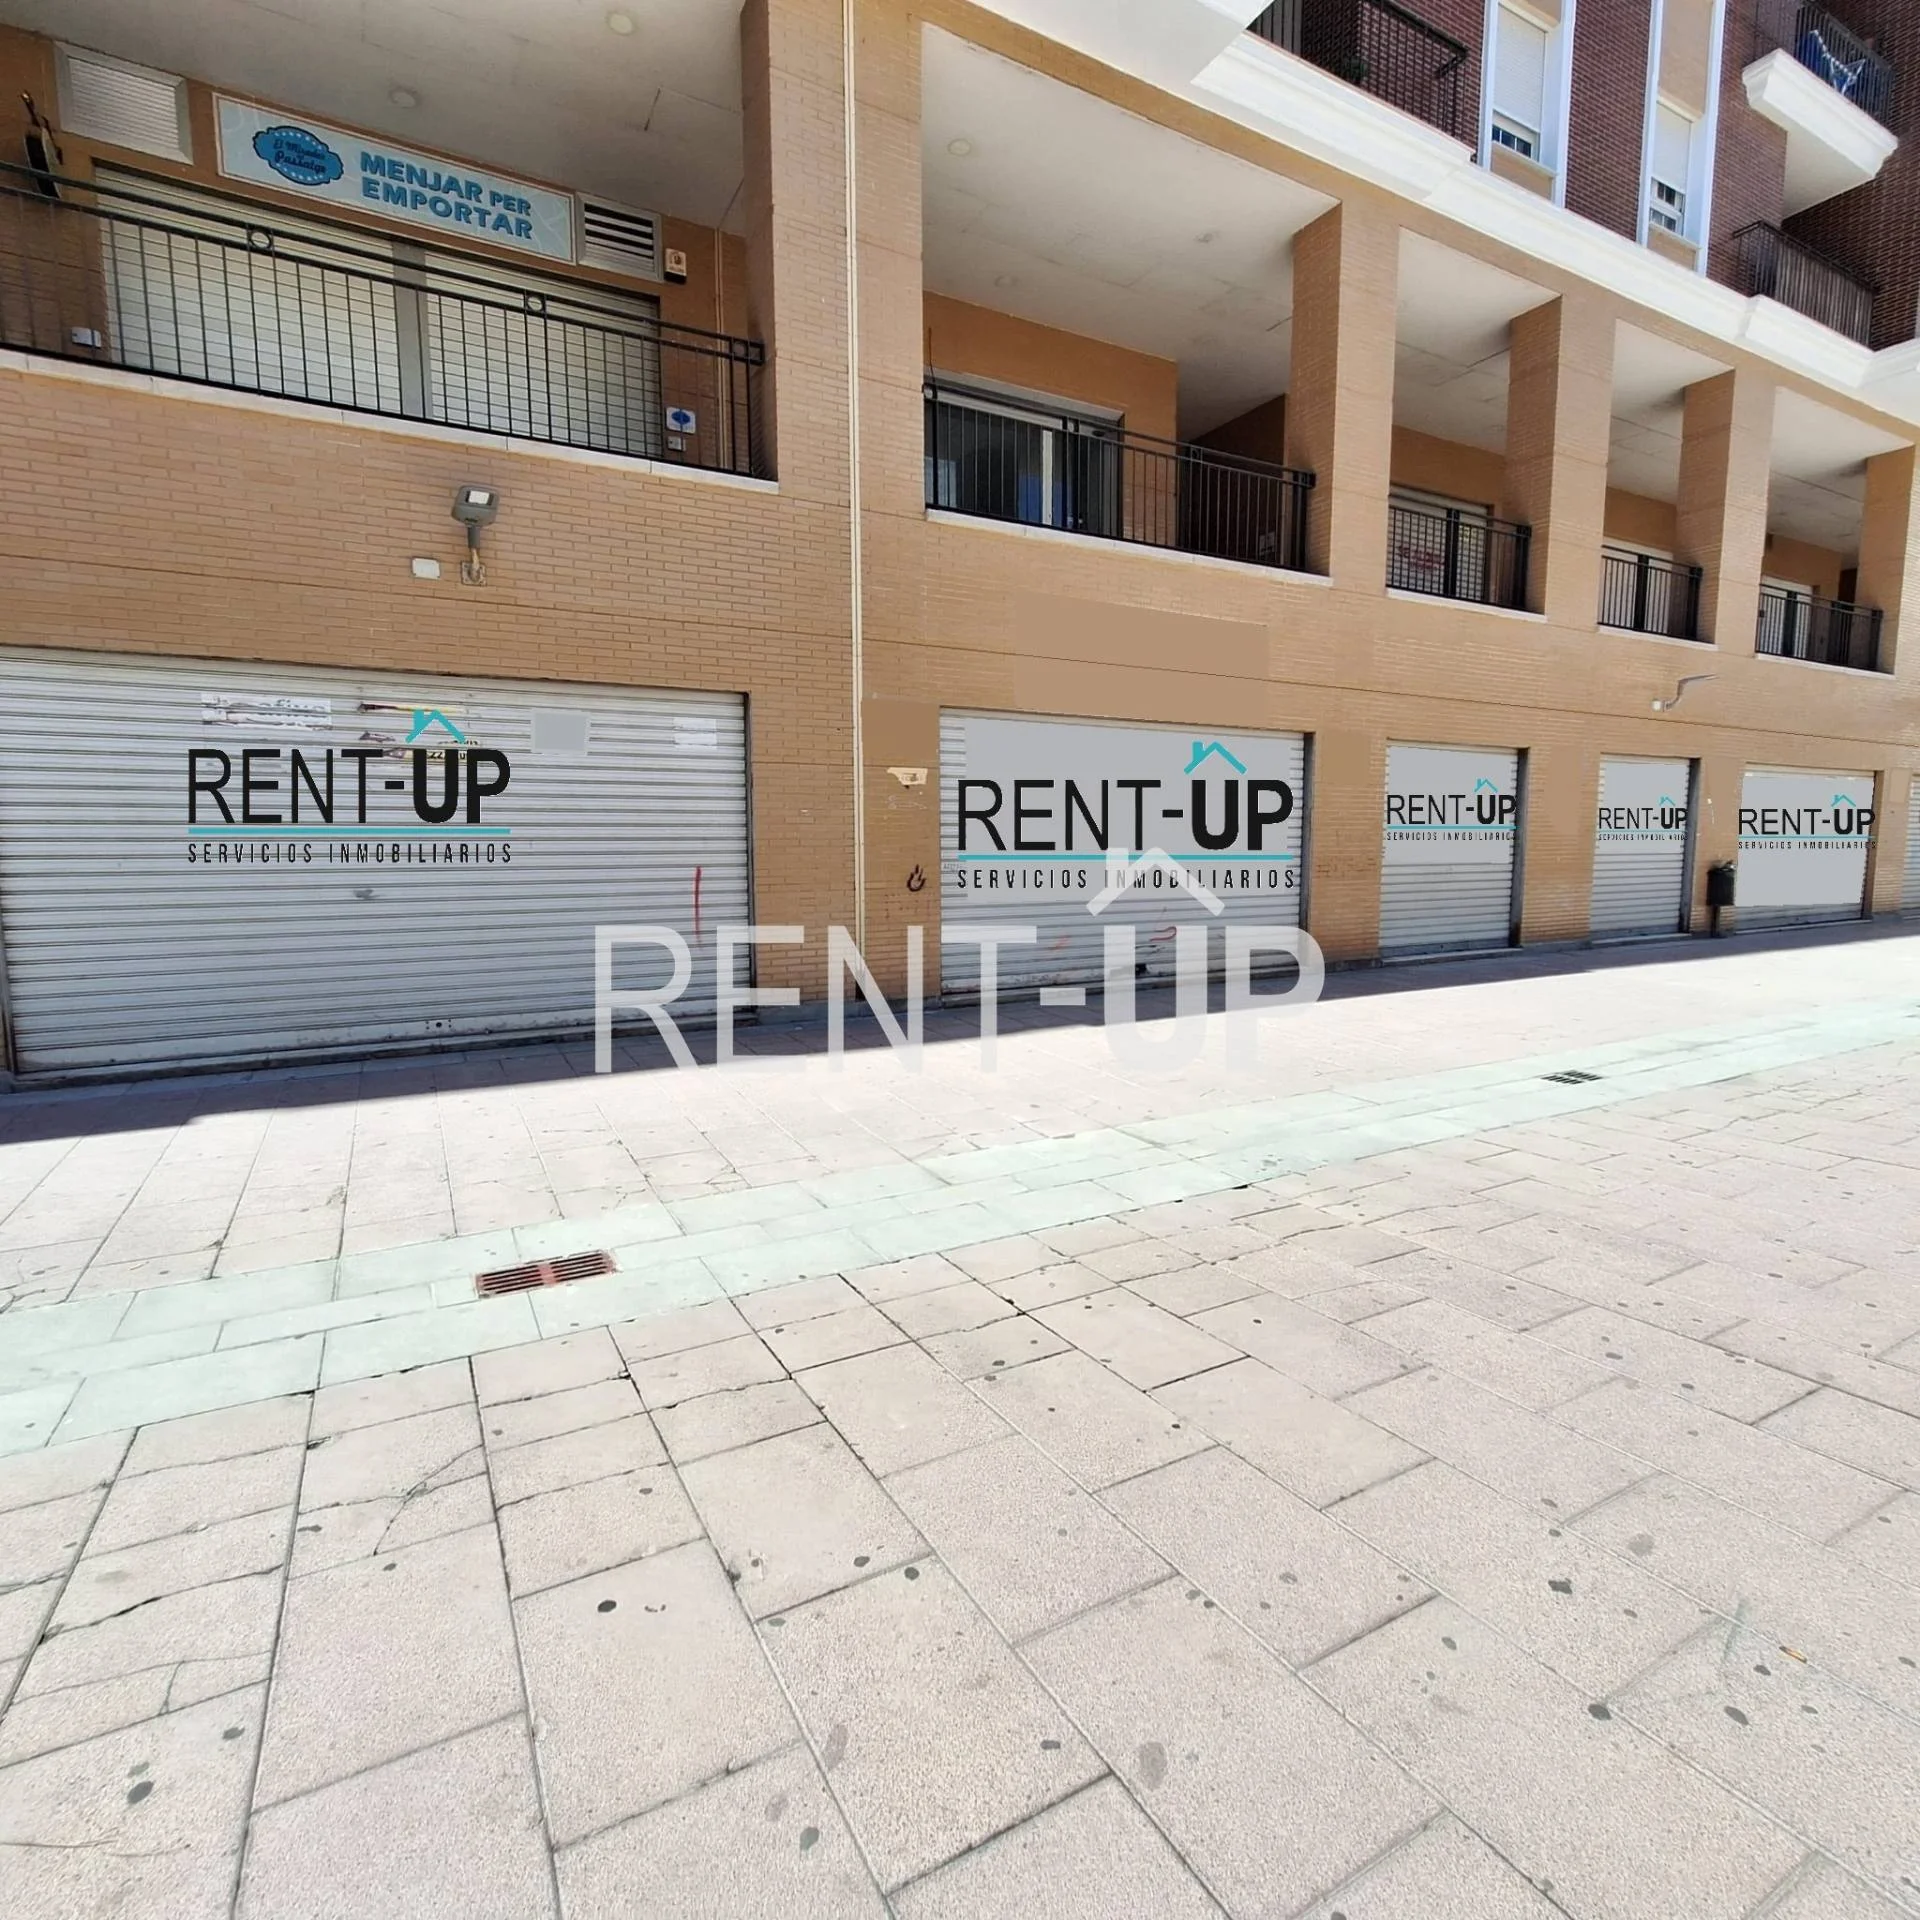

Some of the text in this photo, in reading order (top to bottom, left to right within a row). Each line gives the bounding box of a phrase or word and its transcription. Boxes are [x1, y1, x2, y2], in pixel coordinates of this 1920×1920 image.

[360, 151, 532, 216] MENJAR PER
[362, 176, 533, 240] EMPORTAR
